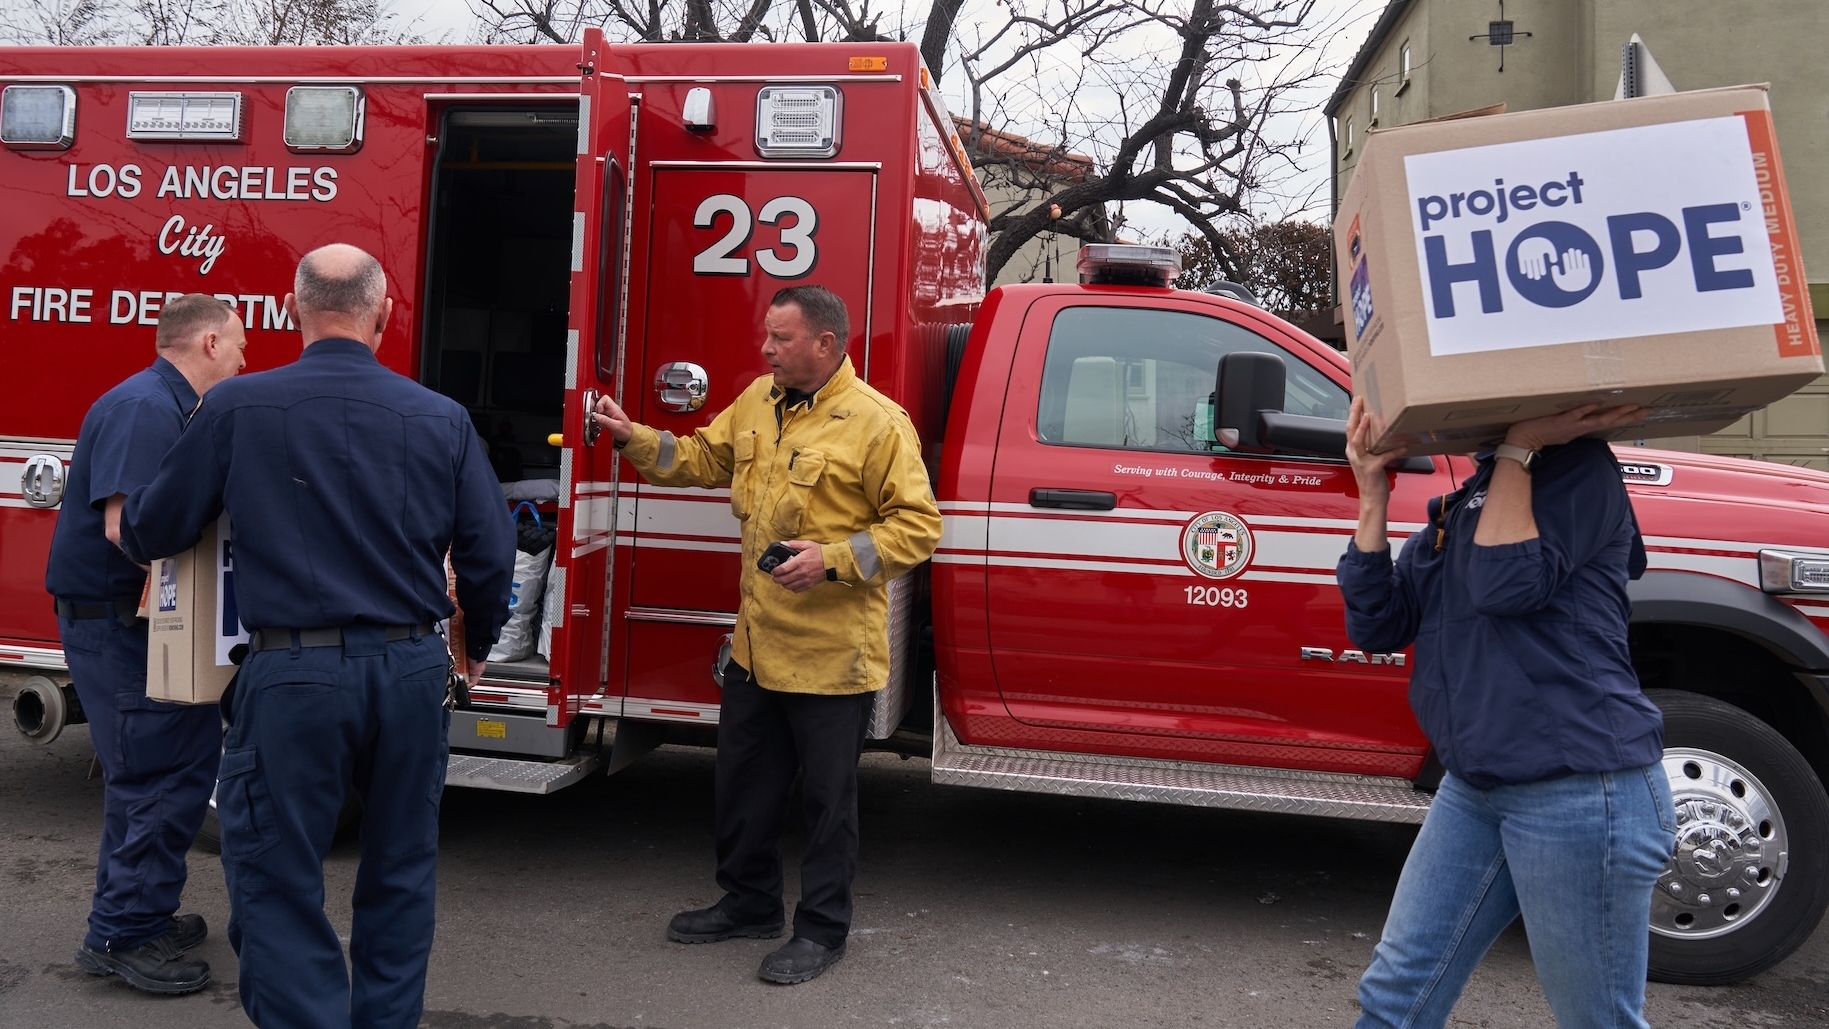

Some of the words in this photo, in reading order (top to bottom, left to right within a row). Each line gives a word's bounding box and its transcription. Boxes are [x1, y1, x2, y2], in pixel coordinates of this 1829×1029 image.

[67, 163, 143, 198] LOS
[157, 164, 339, 202] ANGELES
[1418, 171, 1584, 231] project
[1752, 152, 1781, 234] MEDIUM
[158, 214, 226, 275] City
[693, 193, 818, 279] 23
[1771, 241, 1791, 285] DUTY
[10, 286, 94, 323] FIRE
[1781, 292, 1803, 346] HEAVY
[1114, 465, 1152, 477] Serving
[1155, 467, 1178, 477] with
[1181, 469, 1226, 481] Courage,
[1229, 471, 1275, 484] Integrity
[1278, 475, 1289, 484] &
[1292, 475, 1321, 486] Pride
[1223, 516, 1246, 536] ANGELES
[1184, 585, 1249, 608] 12093
[1300, 646, 1407, 667] RAM
